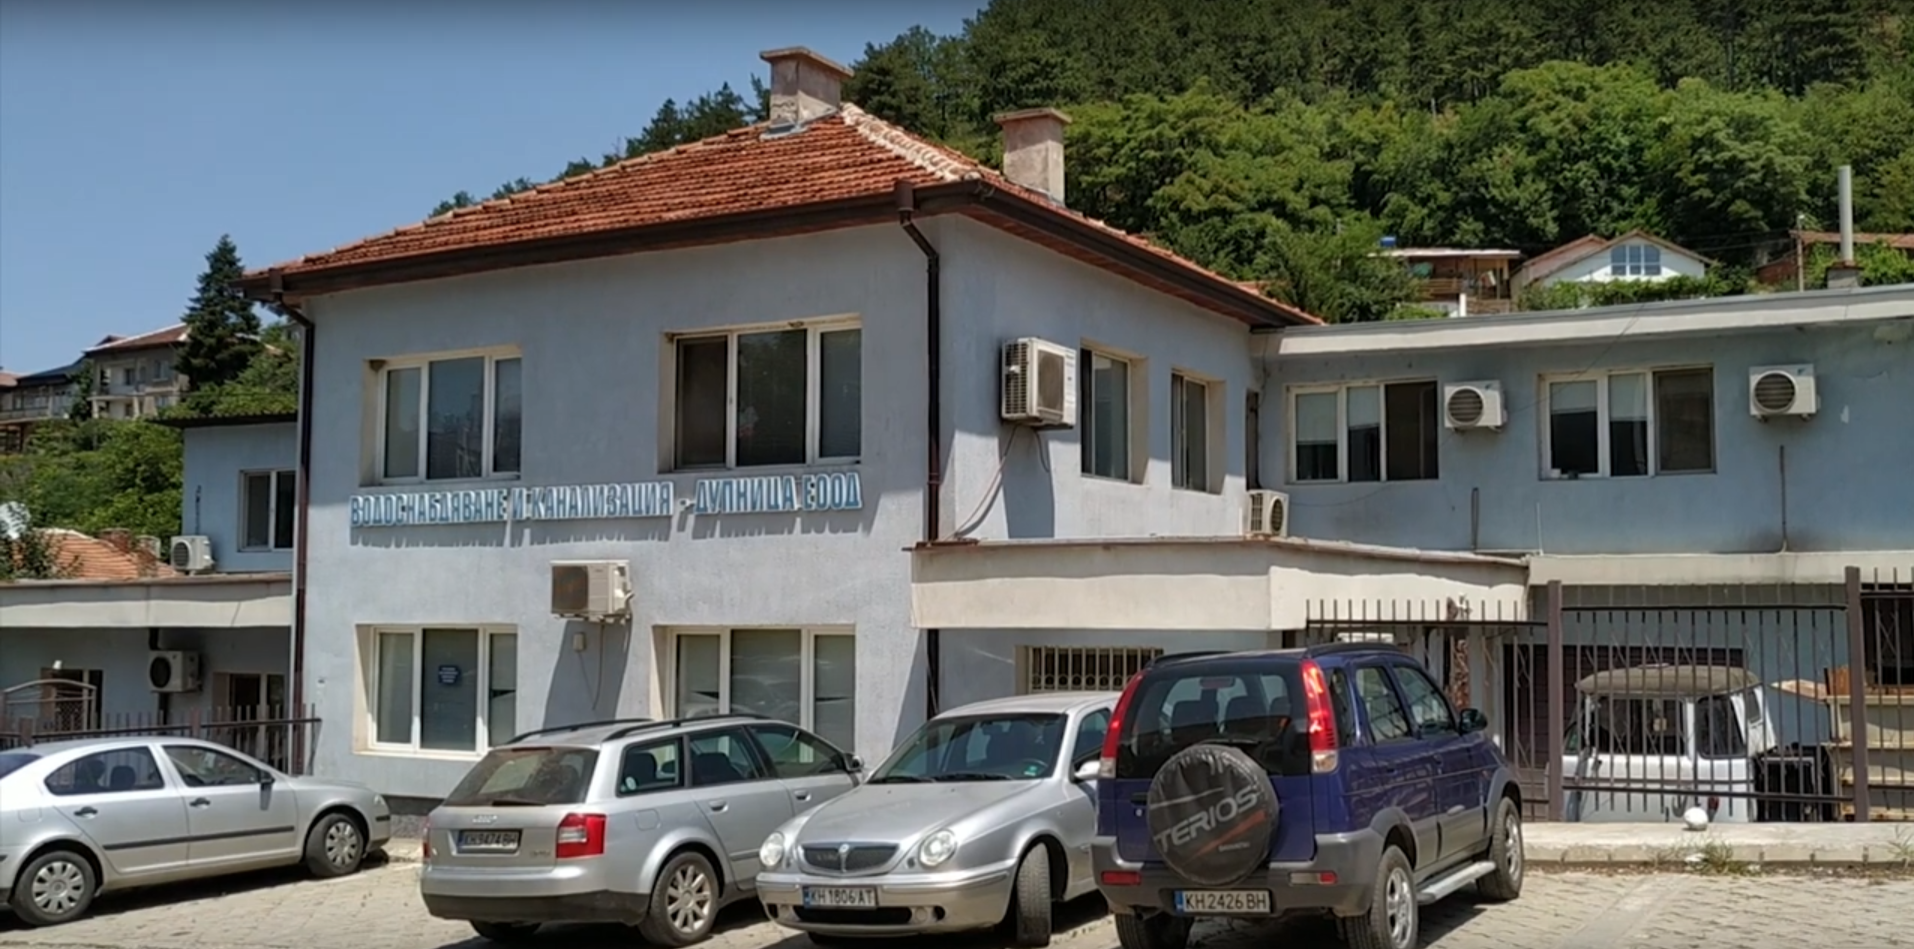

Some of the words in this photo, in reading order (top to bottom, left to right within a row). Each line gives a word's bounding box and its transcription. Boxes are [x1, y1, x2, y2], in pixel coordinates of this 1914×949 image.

[350, 488, 507, 527] ВОДОСНАБДЯВАНЕ
[511, 486, 527, 520] И
[530, 481, 673, 519] КАНАЛИЗАЦИЯ
[694, 475, 797, 515] ДУПНИЦА
[801, 473, 862, 512] ЕООД
[1153, 785, 1258, 853] TERIOS
